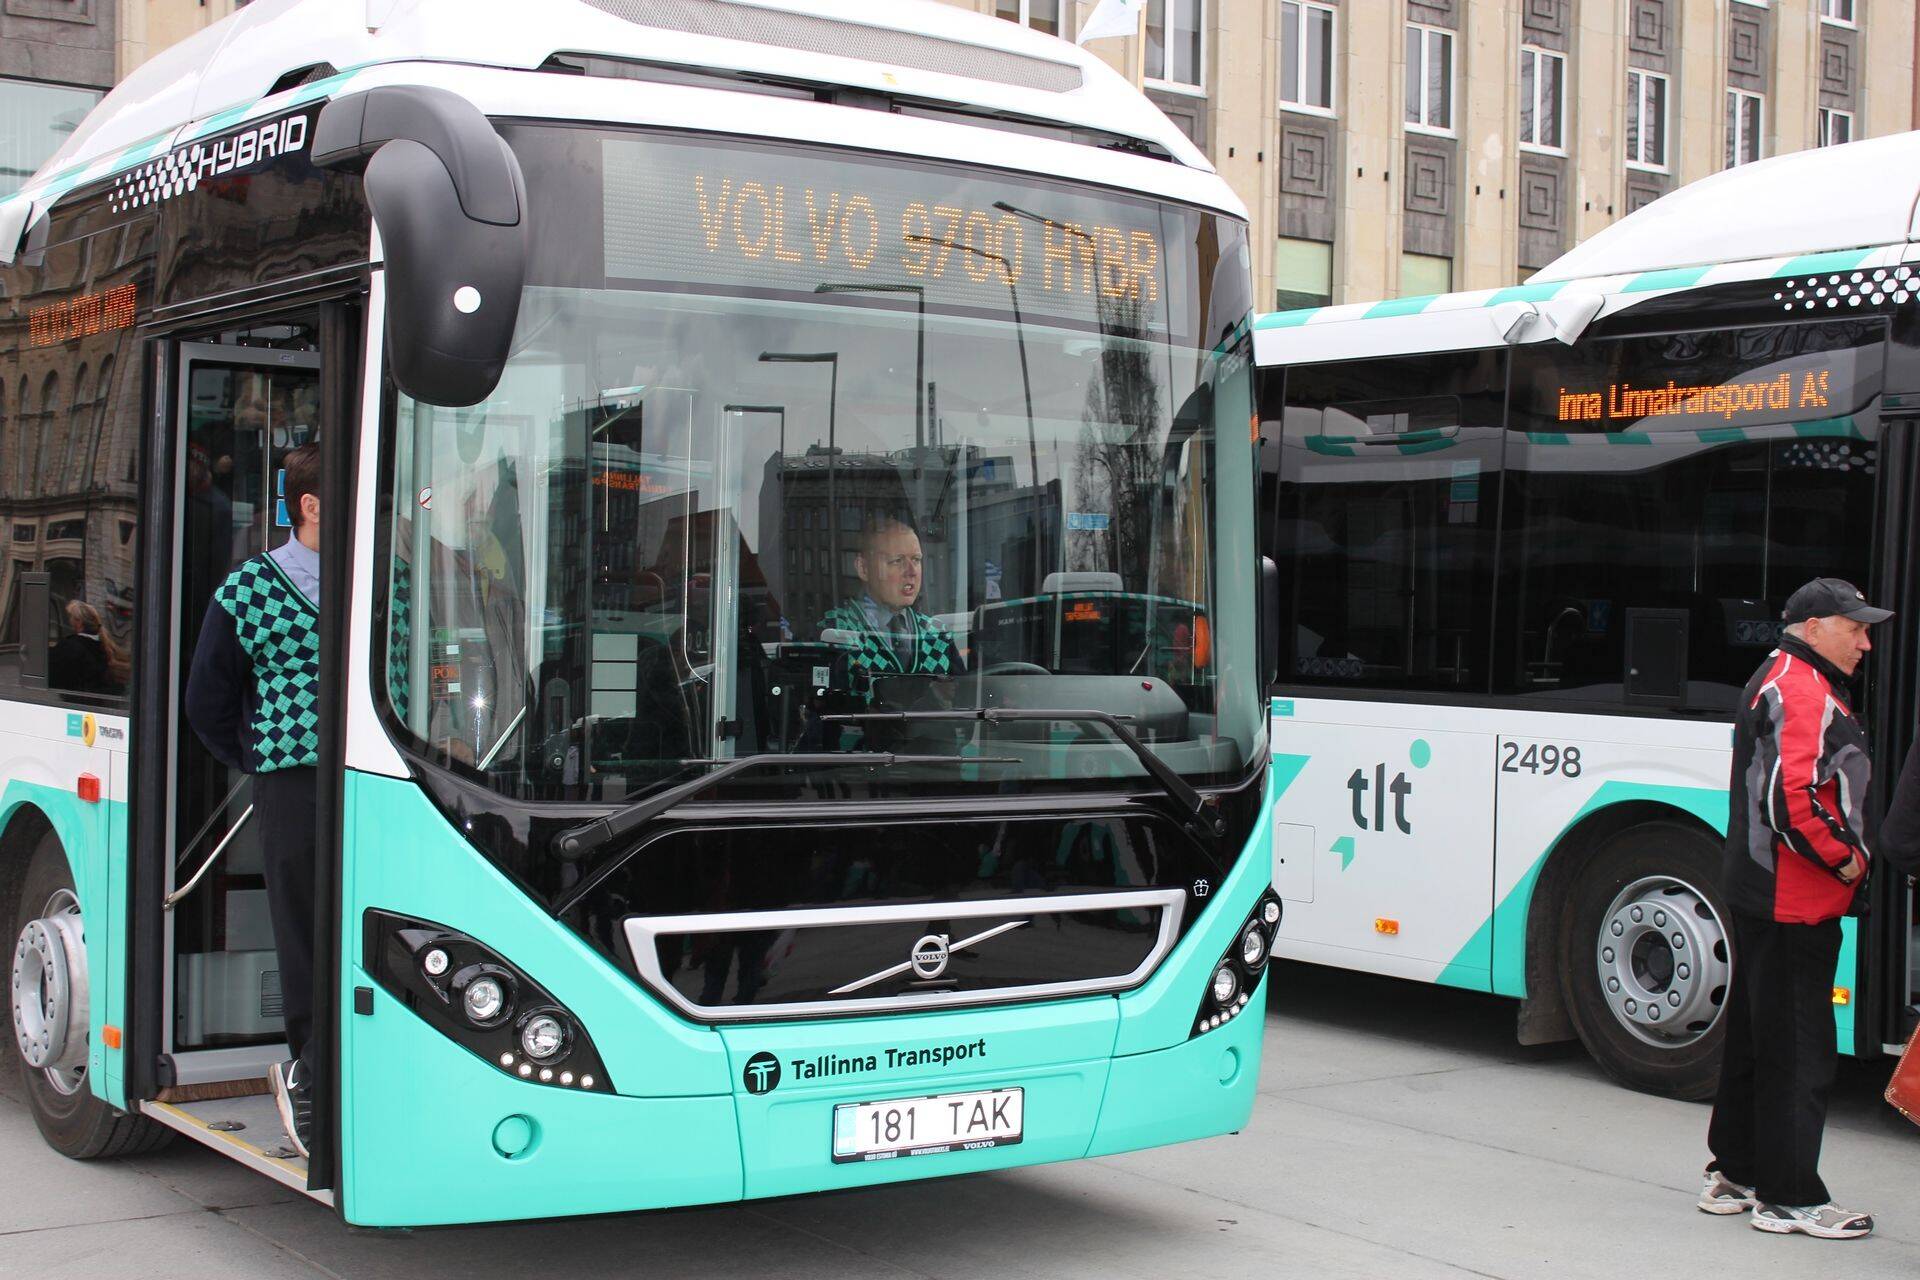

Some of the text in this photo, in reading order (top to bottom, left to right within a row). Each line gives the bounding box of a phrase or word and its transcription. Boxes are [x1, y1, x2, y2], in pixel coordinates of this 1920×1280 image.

[197, 115, 307, 180] HYBRID
[695, 175, 1157, 301] VOLVO 9700 HYBR
[1559, 387, 1602, 420] inna
[1608, 372, 1791, 420] Linnatranspordi
[1501, 741, 1582, 779] 2498
[1347, 762, 1412, 835] tlt
[914, 953, 947, 961] VOLVO
[791, 1038, 986, 1080] Tallinna Transport
[871, 1095, 1012, 1144] 181 TAK
[962, 1140, 996, 1151] VOLVO
